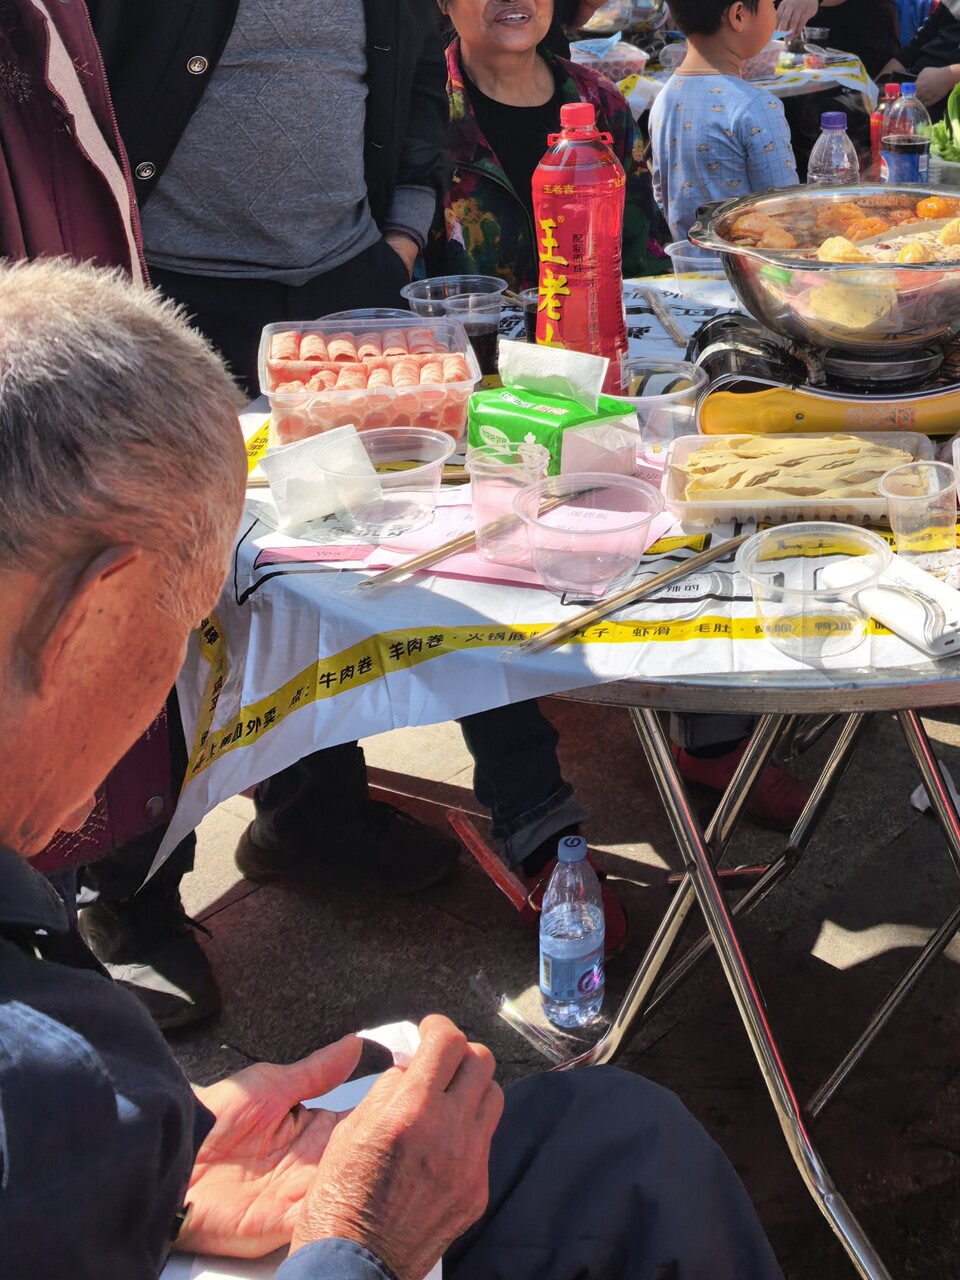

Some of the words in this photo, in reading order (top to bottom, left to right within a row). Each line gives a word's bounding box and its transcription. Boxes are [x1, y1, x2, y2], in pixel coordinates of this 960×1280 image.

[543, 184, 575, 195] 王老吉
[319, 656, 374, 689] 牛肉卷
[389, 634, 444, 662] 羊肉卷
[632, 627, 671, 638] 虾滑
[693, 623, 731, 634] 毛肚
